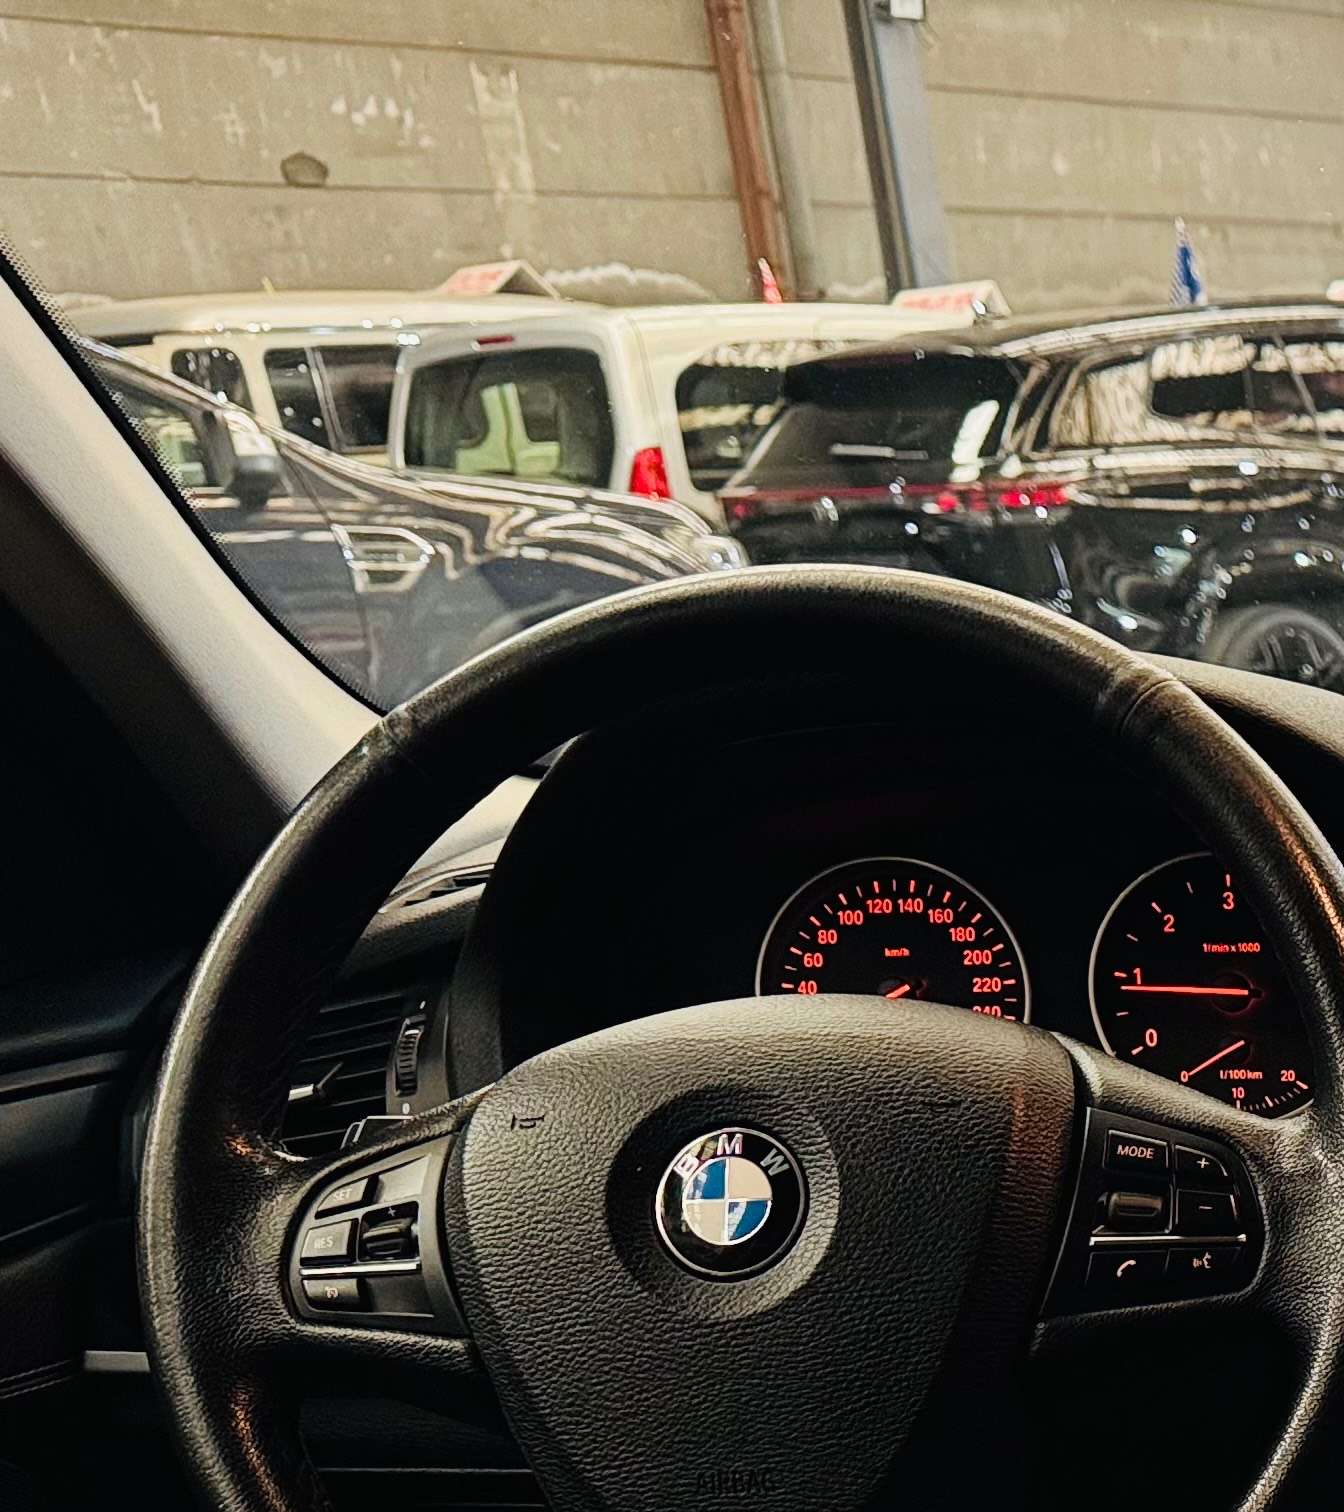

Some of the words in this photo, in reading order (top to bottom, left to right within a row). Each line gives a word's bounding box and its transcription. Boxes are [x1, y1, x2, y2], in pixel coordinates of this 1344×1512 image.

[866, 899, 893, 914] 120
[898, 898, 924, 913] 140
[1222, 891, 1235, 910] 3
[837, 910, 864, 926] 100
[928, 908, 953, 923] 160
[1163, 914, 1176, 932] 2
[817, 929, 838, 944] 80
[949, 926, 976, 942] 180
[803, 953, 823, 968] 60
[963, 950, 992, 965] 200
[1133, 967, 1142, 985] 1
[797, 981, 817, 995] 40
[972, 977, 1001, 993] 220
[1145, 1028, 1158, 1047] 0
[1180, 1071, 1189, 1083] 0
[1280, 1070, 1296, 1082] 20
[1231, 1087, 1245, 1098] 10
[674, 1133, 790, 1179] BMW
[1116, 1144, 1155, 1159] MODE
